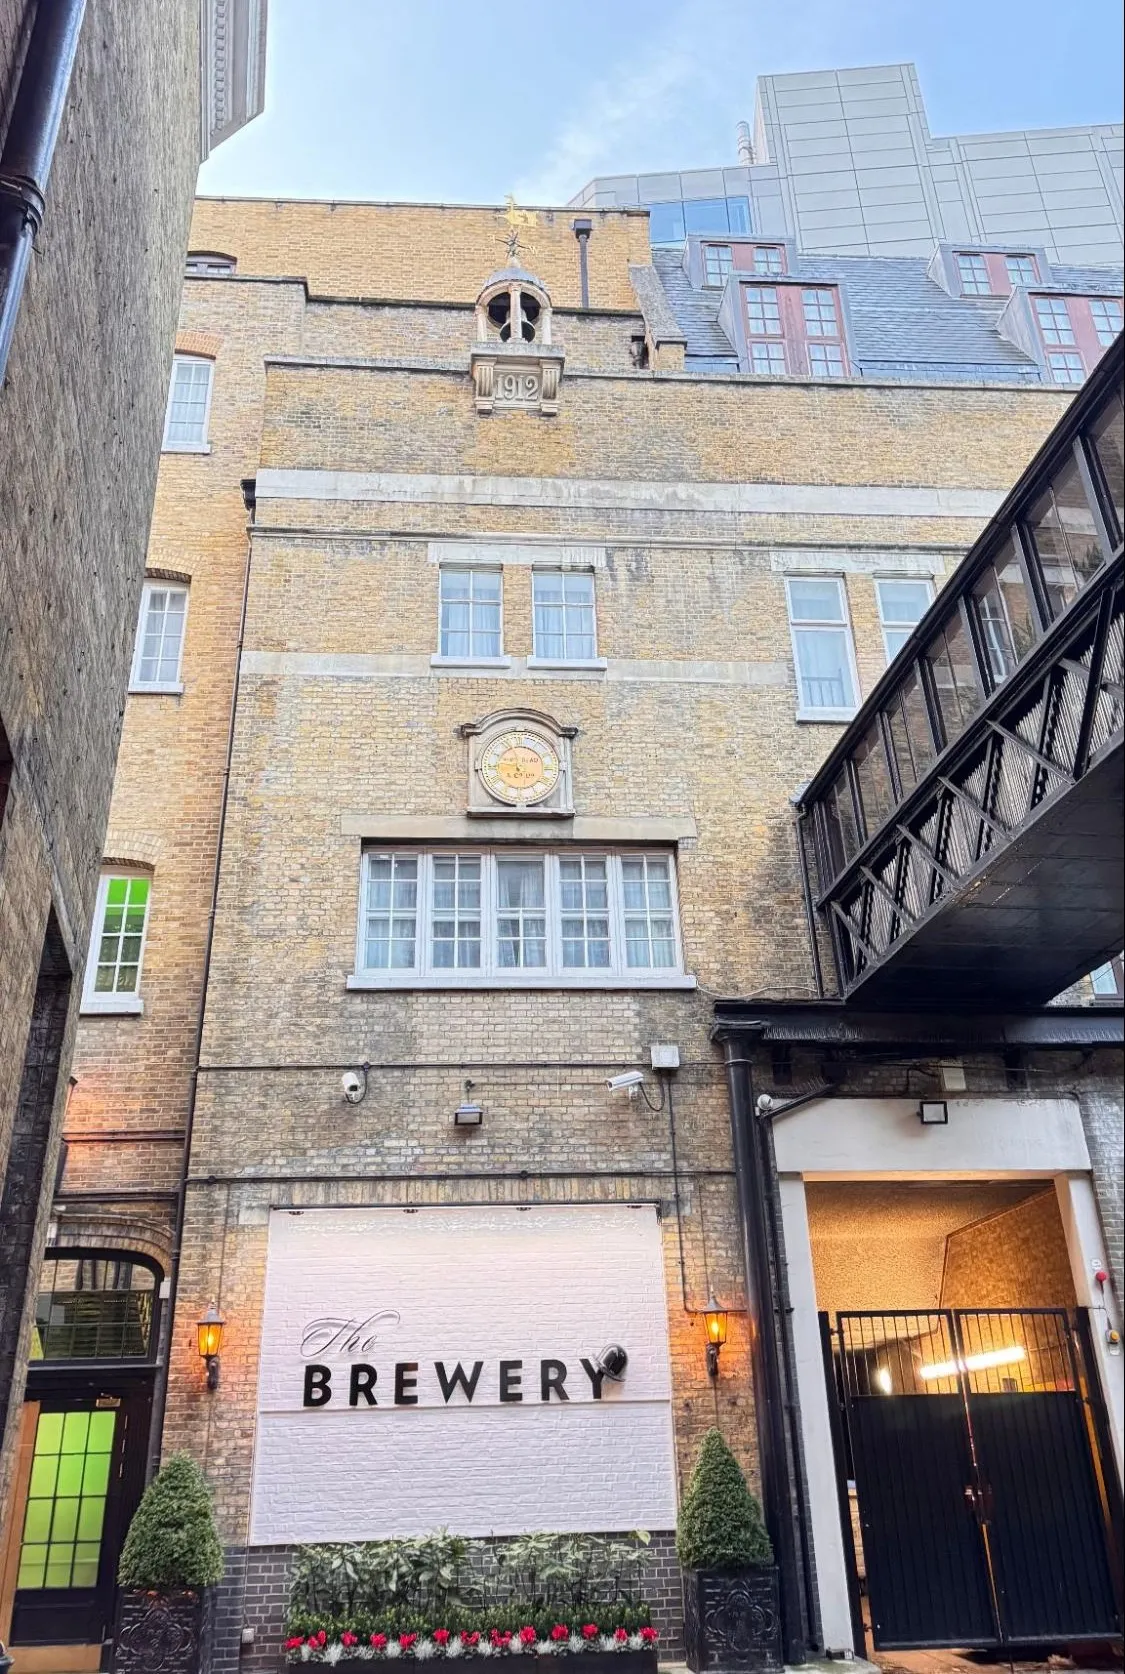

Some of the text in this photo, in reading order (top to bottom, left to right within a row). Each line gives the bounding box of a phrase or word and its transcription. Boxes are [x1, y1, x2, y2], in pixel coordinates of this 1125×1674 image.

[495, 374, 539, 401] 1912
[301, 1310, 401, 1357] The
[303, 1358, 606, 1407] BREWERY
